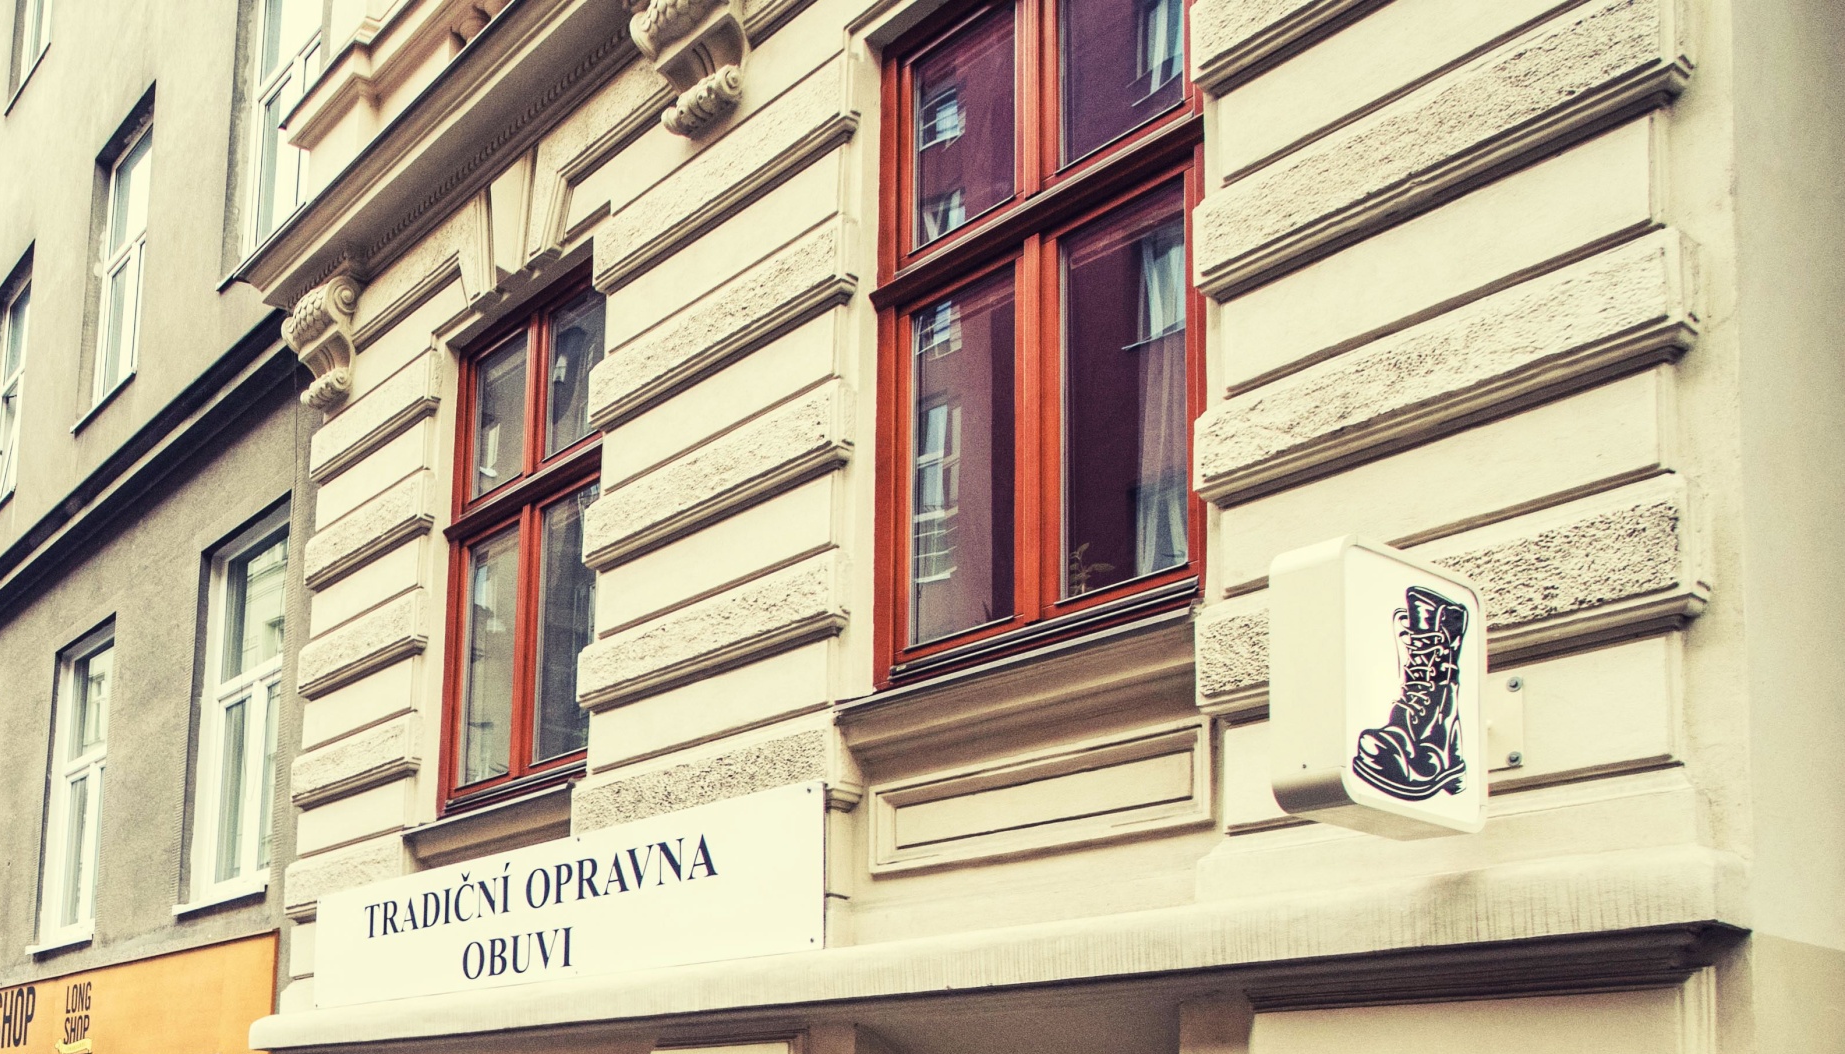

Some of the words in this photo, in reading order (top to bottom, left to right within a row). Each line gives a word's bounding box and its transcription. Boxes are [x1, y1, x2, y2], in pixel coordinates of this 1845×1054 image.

[363, 862, 512, 939] TRADIČNÍ
[525, 833, 719, 909] OPRAVNA
[462, 926, 573, 980] OBUVI
[65, 981, 92, 1014] LONG
[63, 1014, 90, 1045] SHOP
